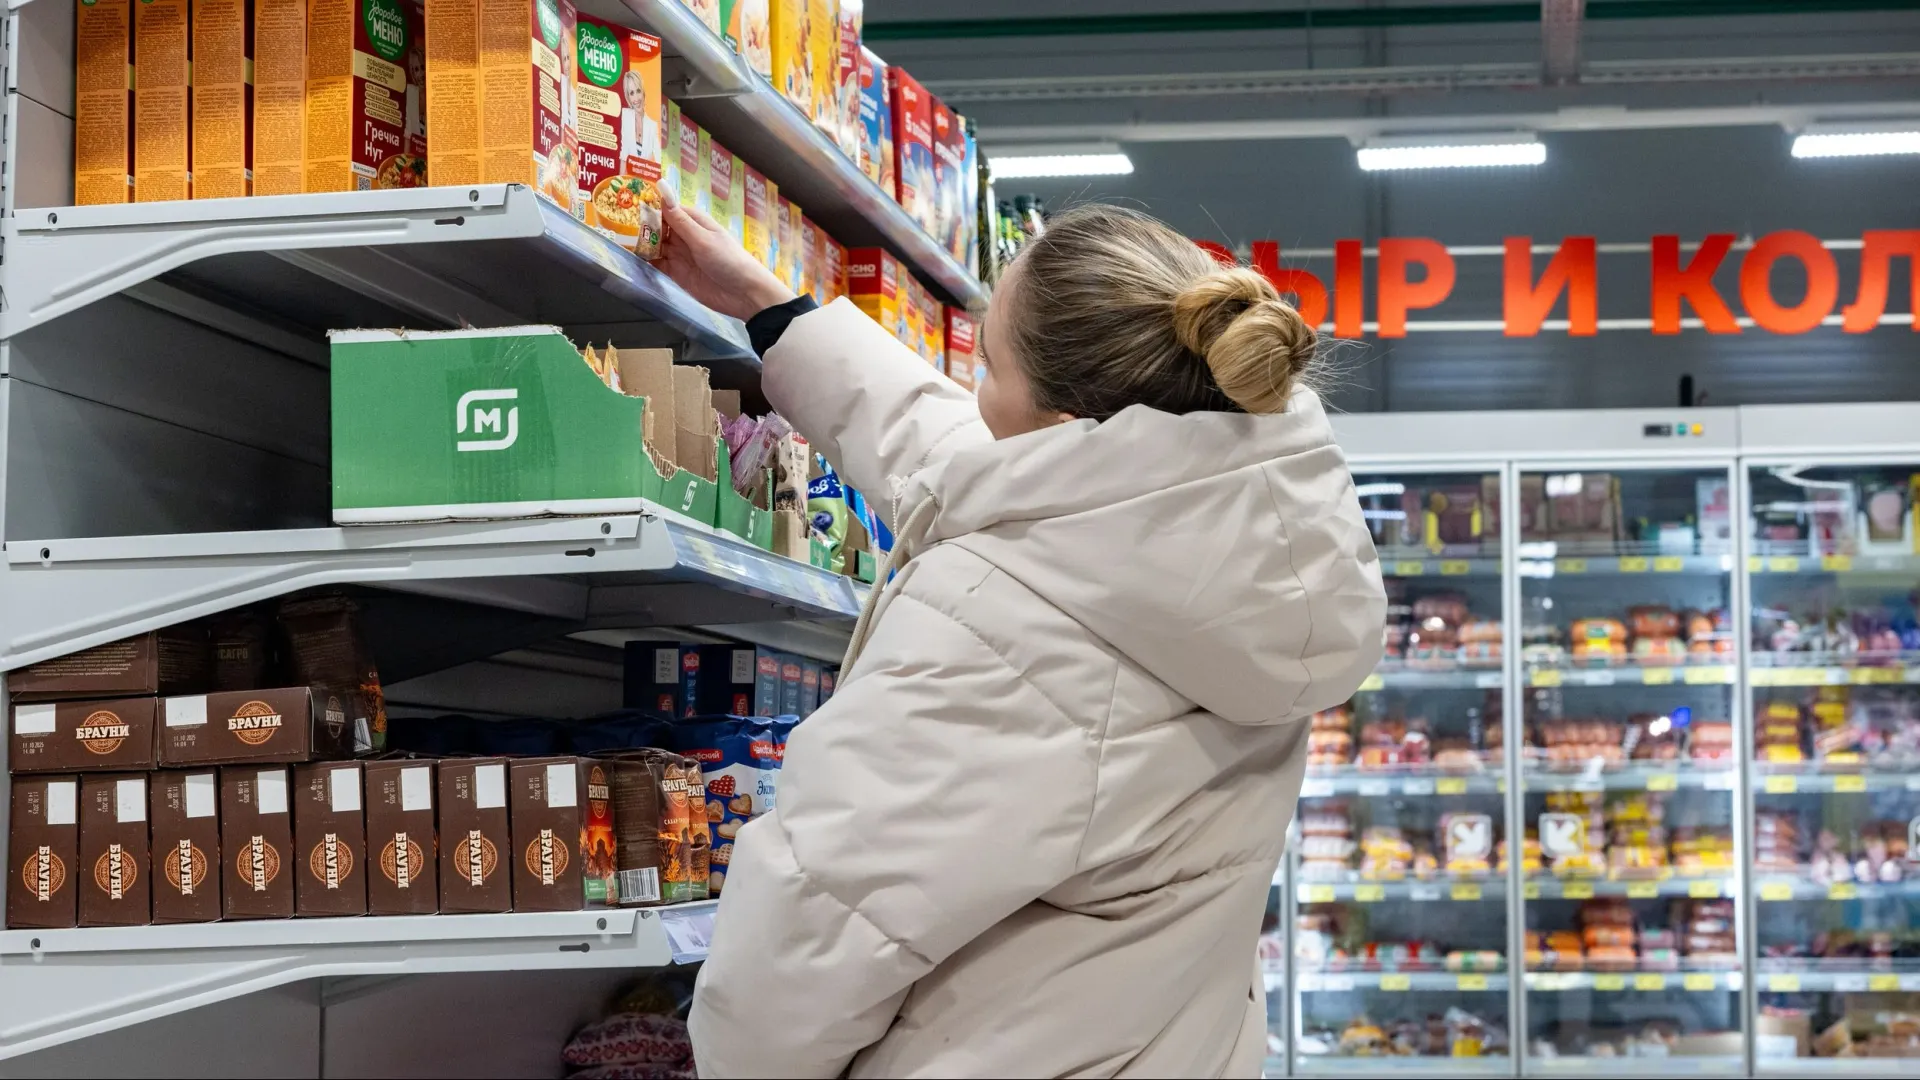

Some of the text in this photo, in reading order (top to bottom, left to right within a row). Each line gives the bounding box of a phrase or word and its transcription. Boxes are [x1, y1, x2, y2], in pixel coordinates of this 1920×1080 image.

[373, 17, 403, 47] МЕНЮ
[579, 28, 616, 52] Здоровое
[584, 46, 617, 73] МЕНЮ
[365, 120, 400, 147] Гречка
[540, 109, 560, 136] Гречка
[365, 140, 383, 162] Нут
[540, 129, 551, 151] Нут
[578, 146, 615, 169] Гречка
[578, 164, 598, 186] Нут
[1503, 235, 1598, 338] И
[75, 725, 129, 739] БРАУНИ
[227, 714, 282, 730] БРАУНИ
[588, 784, 609, 799] БРАУНИ
[179, 839, 193, 895] БРАУНИ
[251, 835, 266, 891] БРАУНИ
[325, 832, 339, 889] БРАУНИ
[395, 832, 409, 889] БРАУНИ
[469, 829, 483, 886] БРАУНИ
[540, 828, 554, 886] БРАУНИ
[38, 845, 50, 901] БРАУНИ
[109, 844, 123, 900] БРАУНИ
